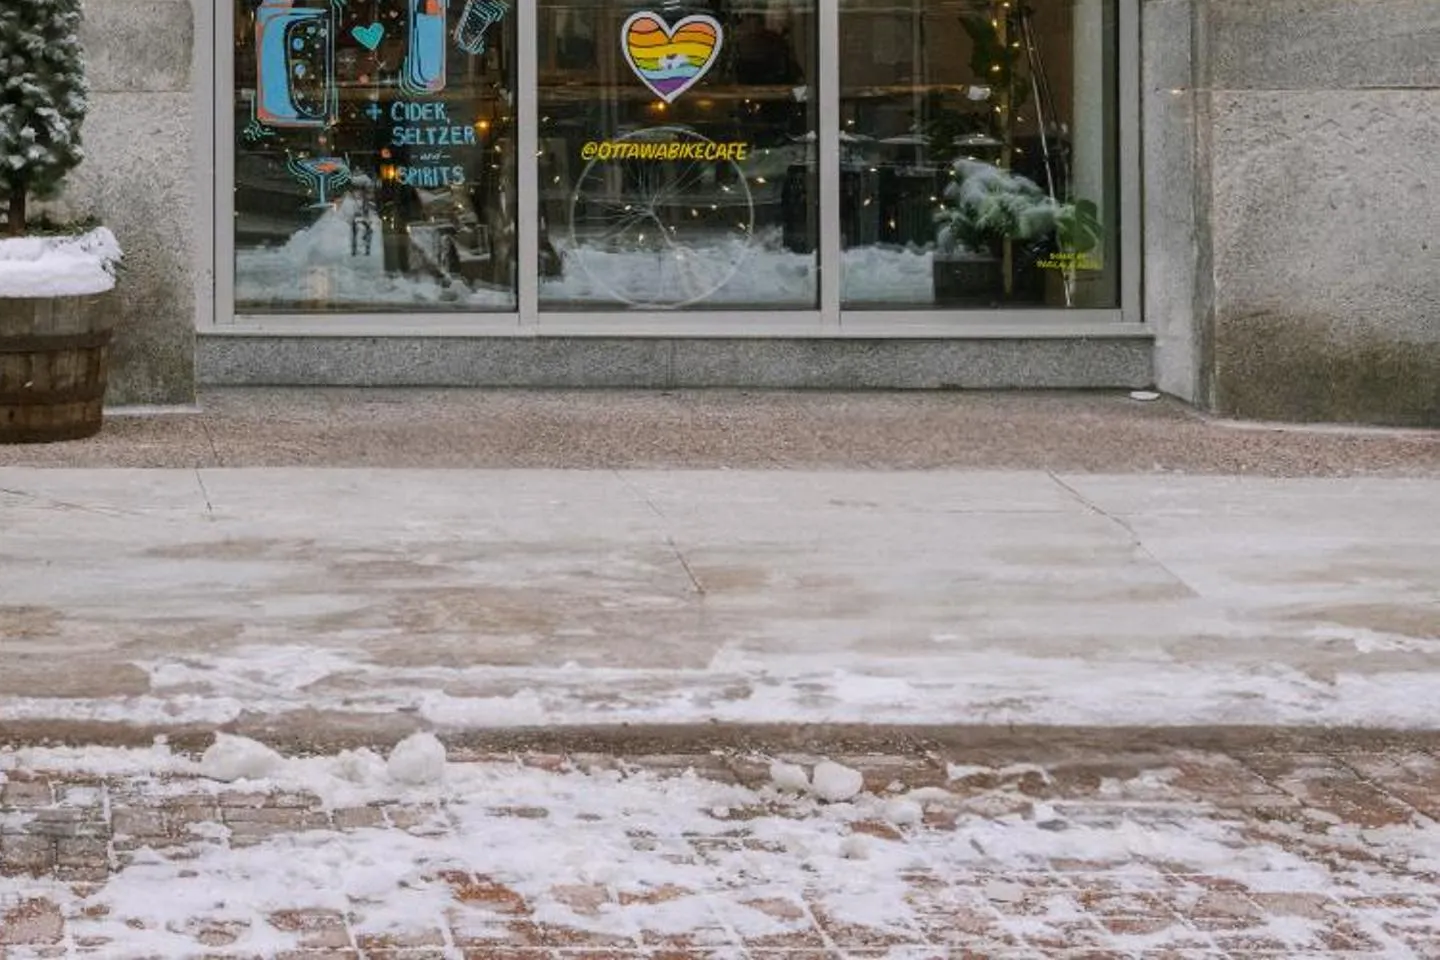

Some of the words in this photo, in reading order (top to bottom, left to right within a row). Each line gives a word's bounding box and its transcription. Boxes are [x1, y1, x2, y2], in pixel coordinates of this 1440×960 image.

[391, 125, 477, 147] SELTZER
[580, 142, 749, 161] @OTTAWABIKECAFE
[396, 165, 466, 187] SPIRITS
